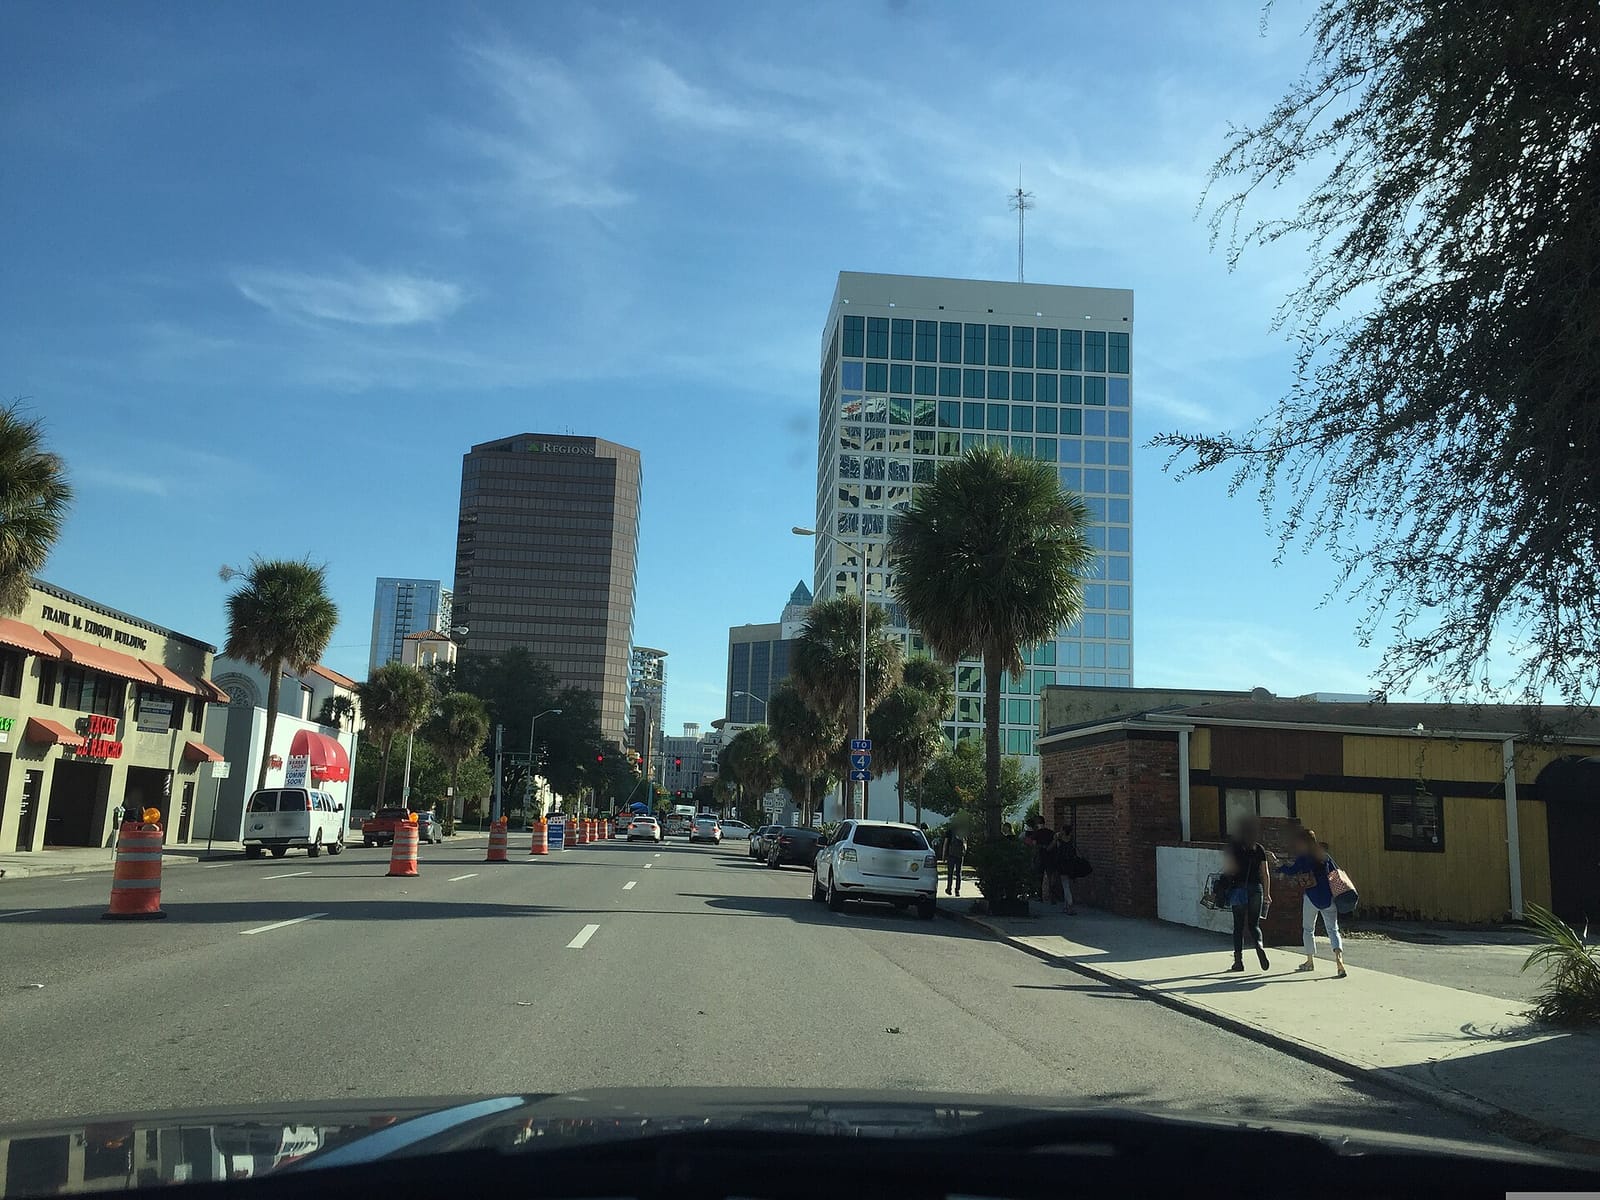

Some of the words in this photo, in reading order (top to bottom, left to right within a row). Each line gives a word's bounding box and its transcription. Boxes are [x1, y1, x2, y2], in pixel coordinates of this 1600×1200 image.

[41, 605, 70, 626] FRANK
[72, 615, 82, 630] M.
[114, 630, 147, 651] BUILDING
[89, 715, 117, 735] TACOS
[90, 739, 123, 758] RANCHO
[857, 756, 865, 767] 4
